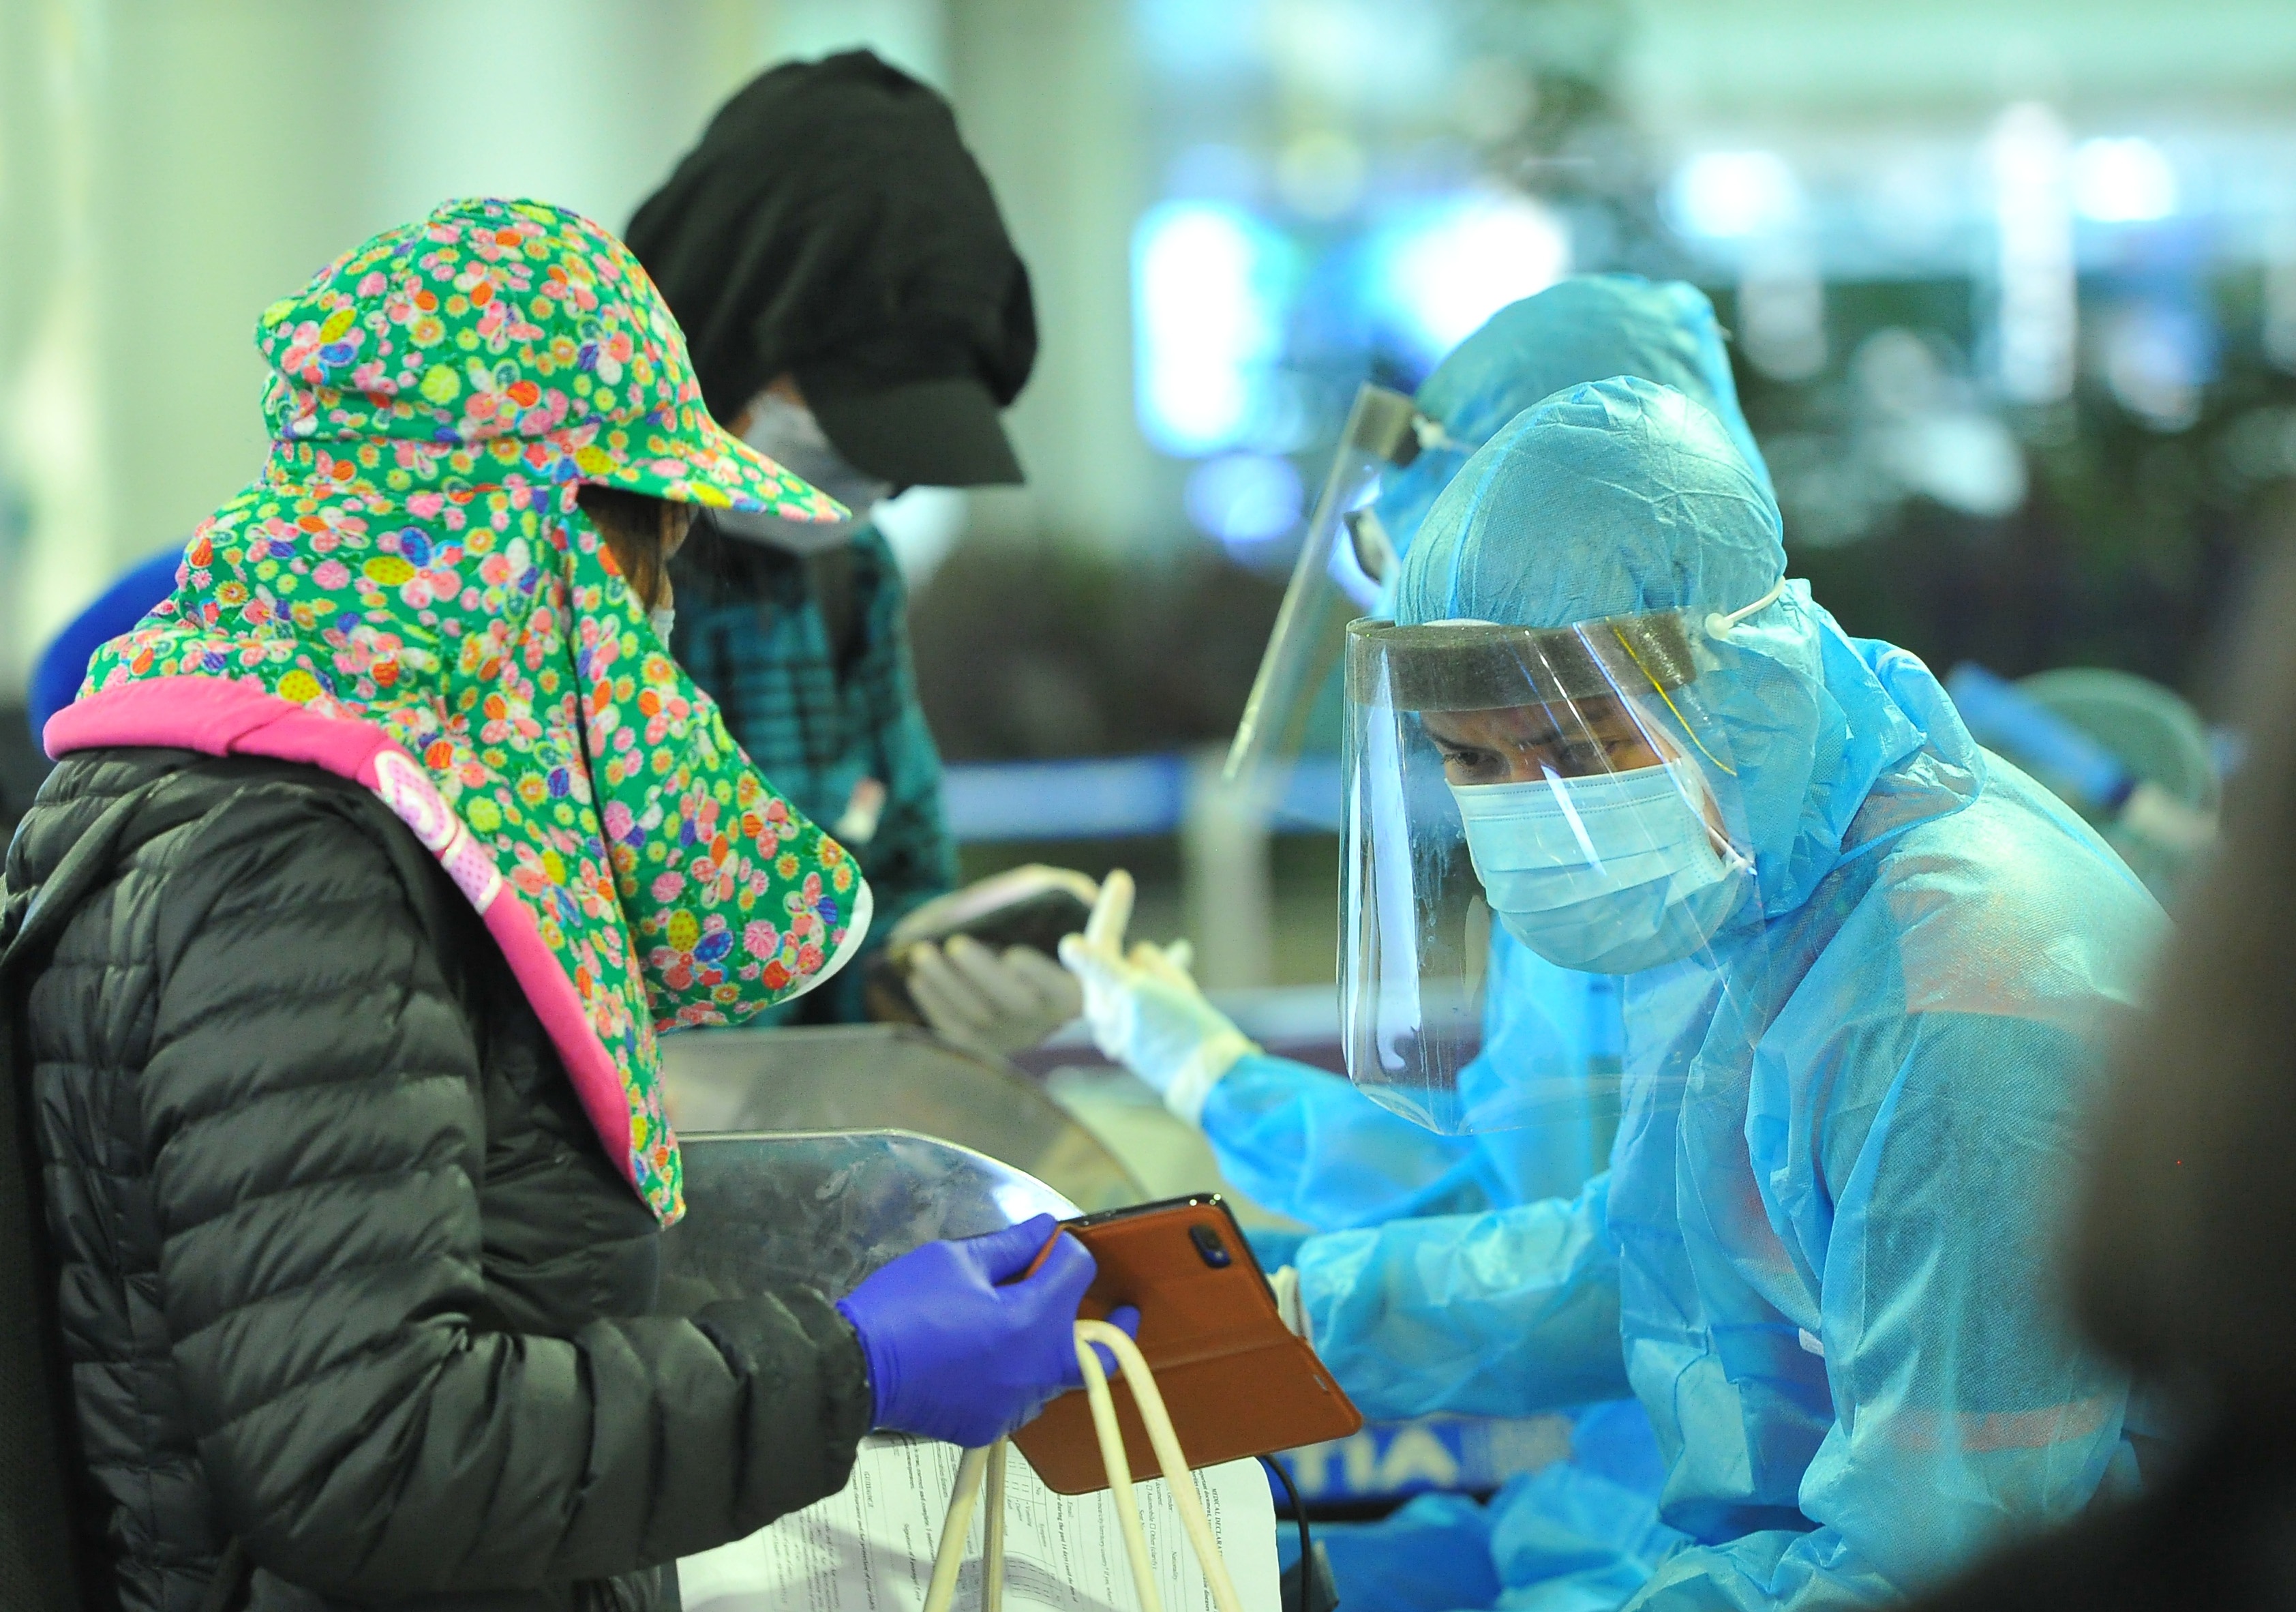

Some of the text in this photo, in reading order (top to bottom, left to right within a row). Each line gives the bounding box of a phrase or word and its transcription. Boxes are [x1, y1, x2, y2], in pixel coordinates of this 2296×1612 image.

[1147, 1491, 1155, 1522] Automobile
[1211, 1489, 1221, 1515] MEDICAL
[1058, 1531, 1067, 1543] past
